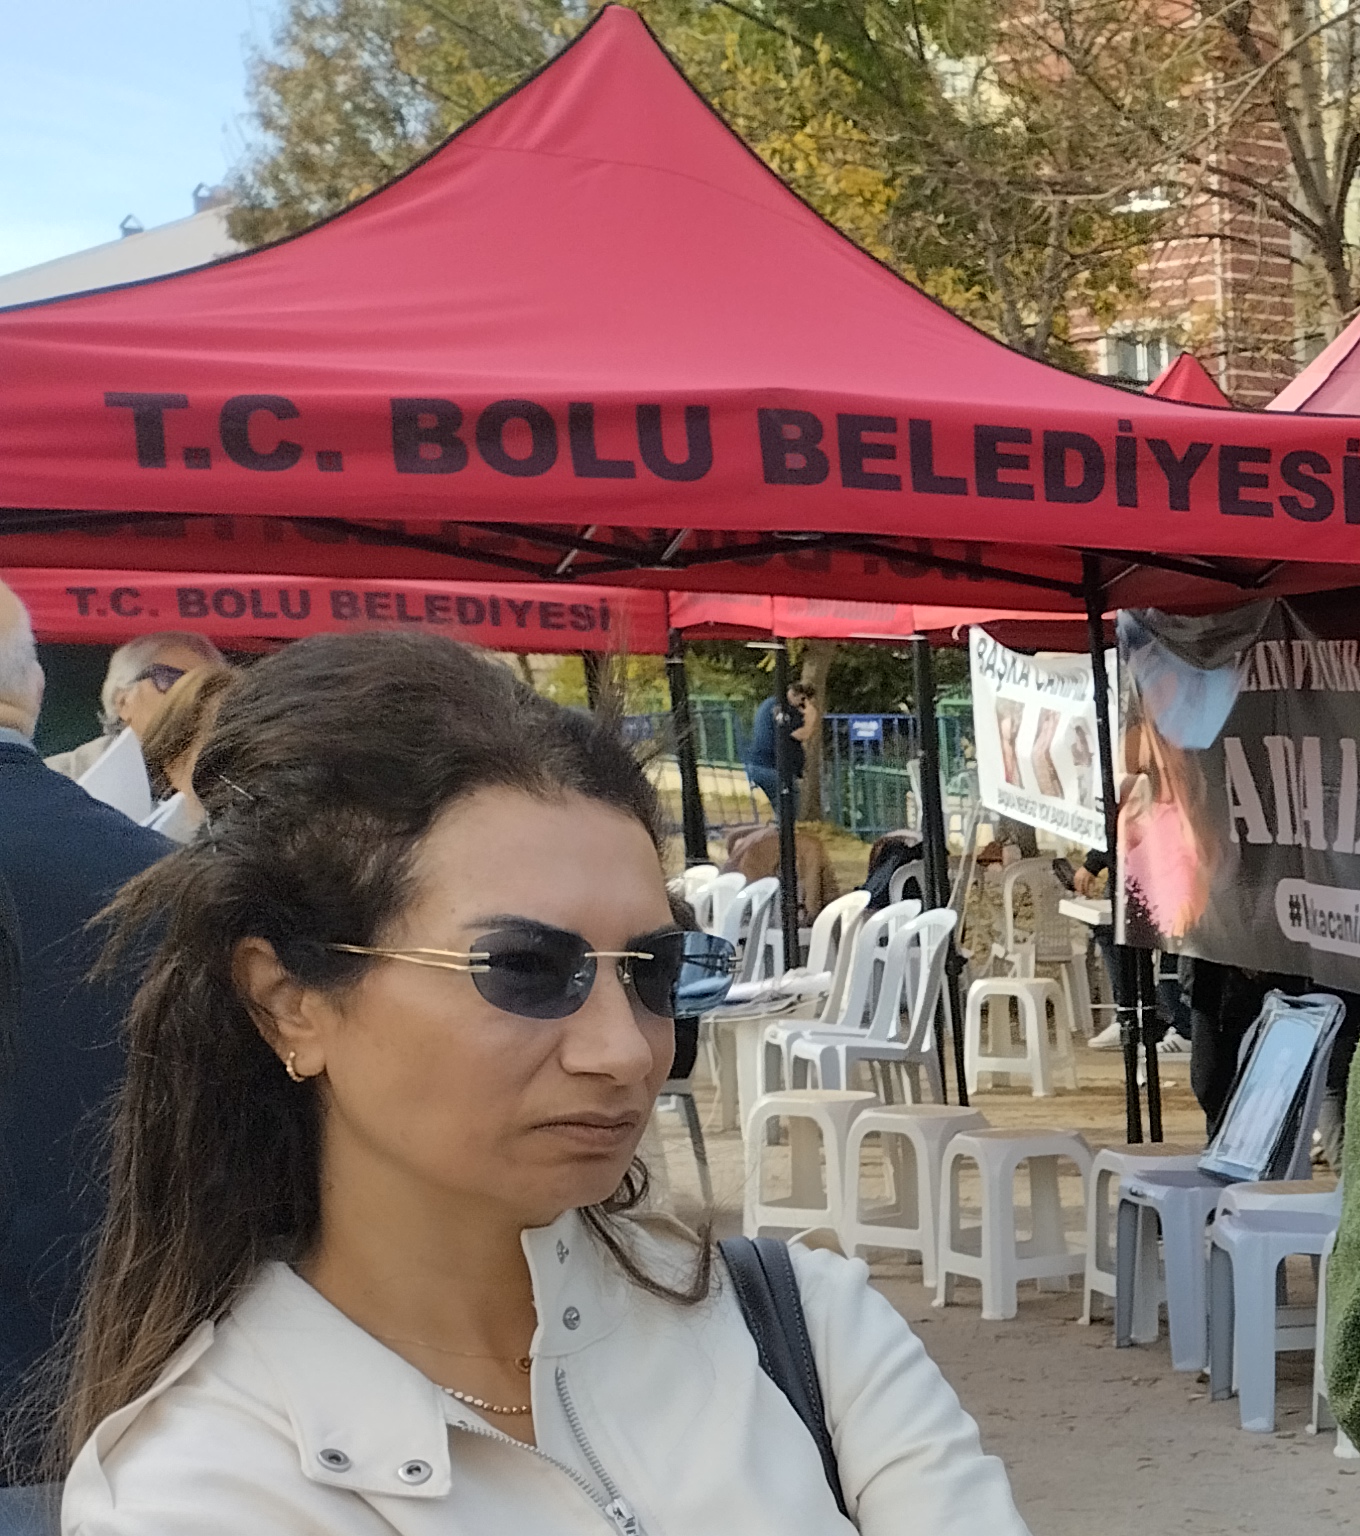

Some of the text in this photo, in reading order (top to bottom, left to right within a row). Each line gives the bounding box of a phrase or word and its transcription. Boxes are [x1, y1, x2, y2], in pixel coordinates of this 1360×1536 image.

[104, 391, 344, 473] T.C.
[390, 397, 714, 483] BOLU
[66, 586, 612, 633] T.C. BOLU BELEDİYESİ
